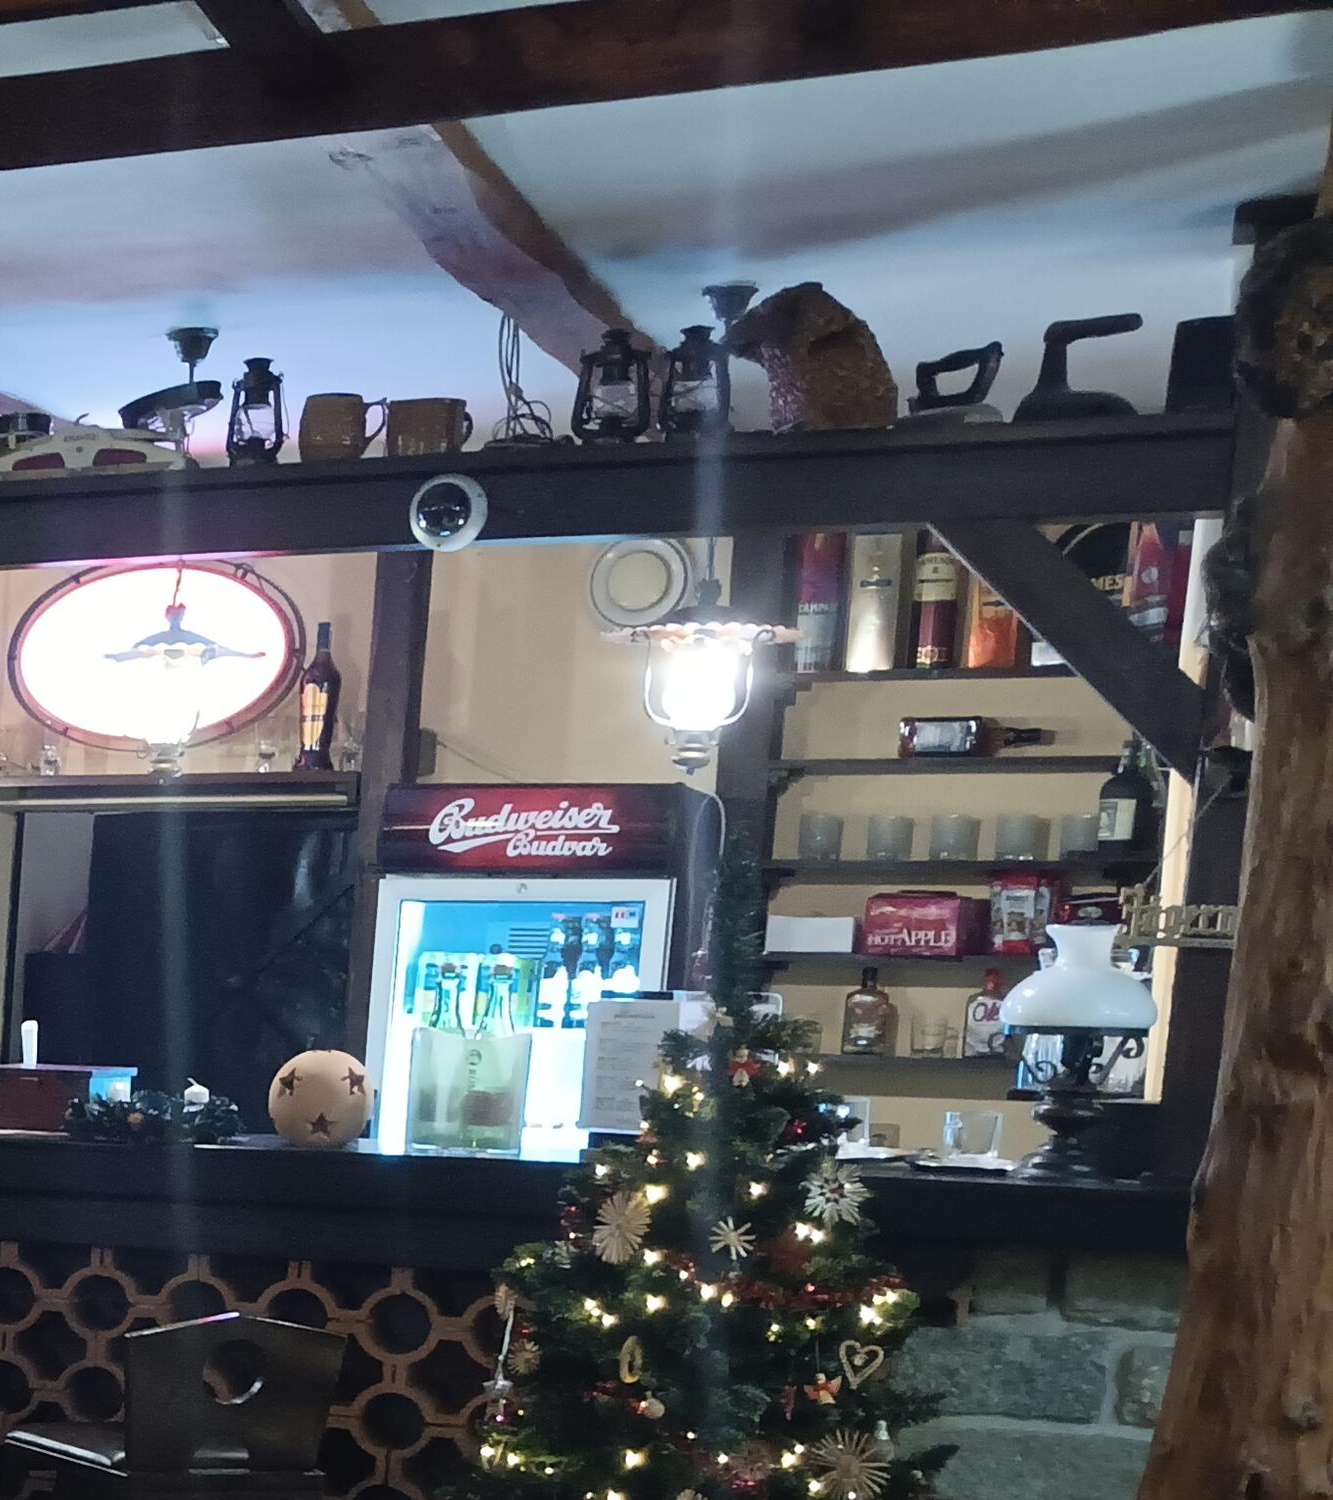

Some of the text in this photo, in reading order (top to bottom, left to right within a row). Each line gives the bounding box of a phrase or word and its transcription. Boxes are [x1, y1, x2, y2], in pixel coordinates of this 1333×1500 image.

[428, 798, 621, 850] Budweiser
[505, 828, 613, 857] Budvar
[867, 927, 954, 947] HOT APPLE
